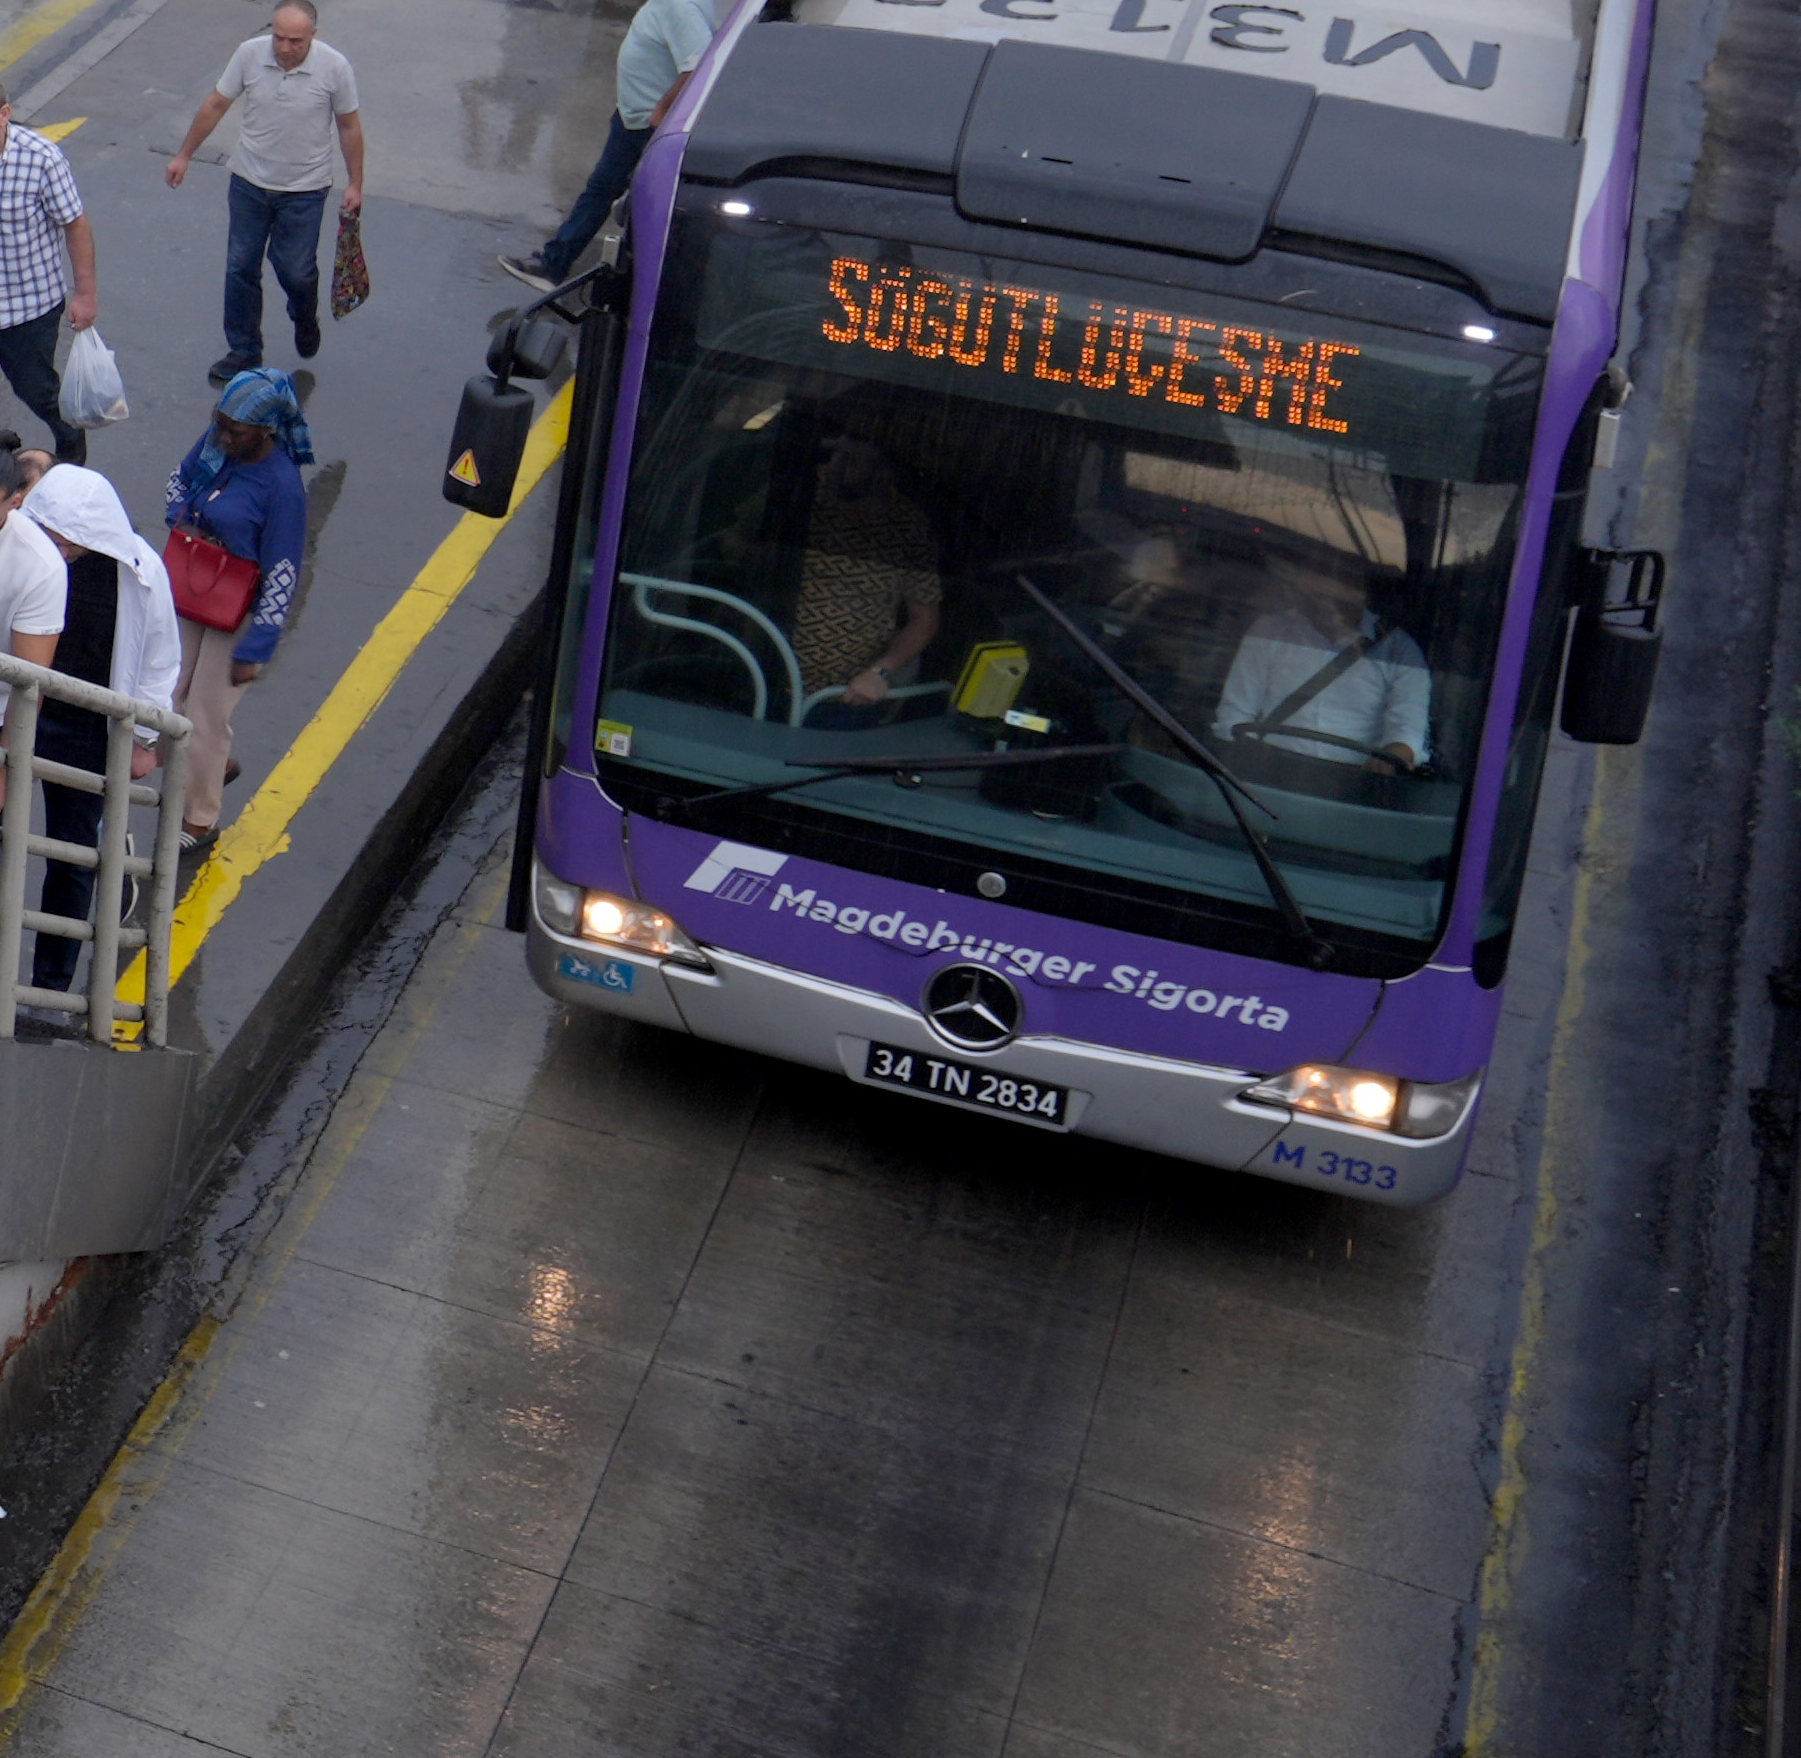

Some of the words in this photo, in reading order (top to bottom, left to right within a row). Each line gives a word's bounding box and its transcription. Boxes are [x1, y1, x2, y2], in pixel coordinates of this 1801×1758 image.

[769, 882, 1096, 988] Magdeburger
[1110, 962, 1290, 1034] Sigorta
[872, 1049, 913, 1084] 34
[925, 1059, 971, 1098] TN
[978, 1073, 1059, 1120] 2834
[1272, 1139, 1305, 1171] M
[1317, 1150, 1398, 1193] 3133
